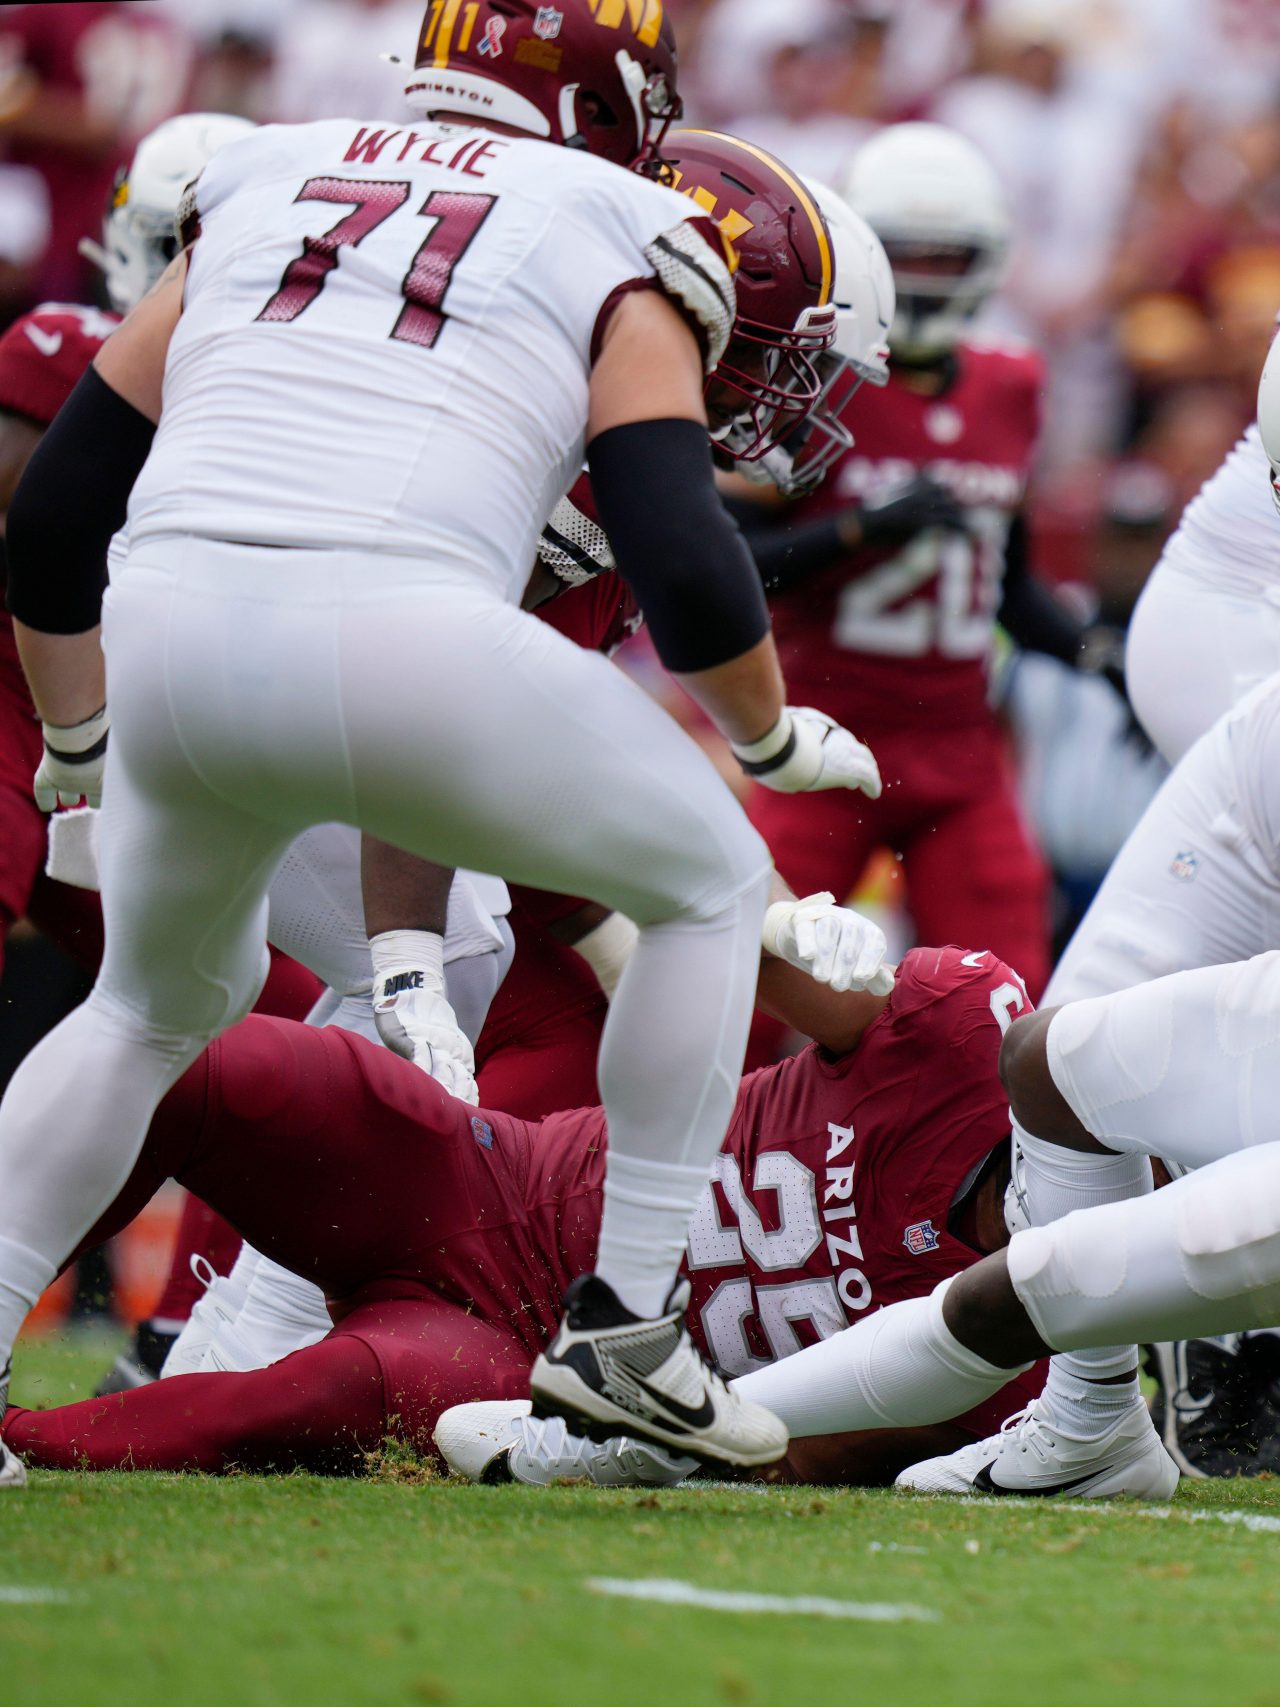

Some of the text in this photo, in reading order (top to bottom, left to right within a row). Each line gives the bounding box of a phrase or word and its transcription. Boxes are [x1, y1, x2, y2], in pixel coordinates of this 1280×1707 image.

[342, 127, 510, 178] WYLIE
[253, 176, 500, 350] 71
[383, 970, 425, 997] NIKE
[686, 1150, 849, 1380] 25
[822, 1121, 885, 1324] ARIZO
